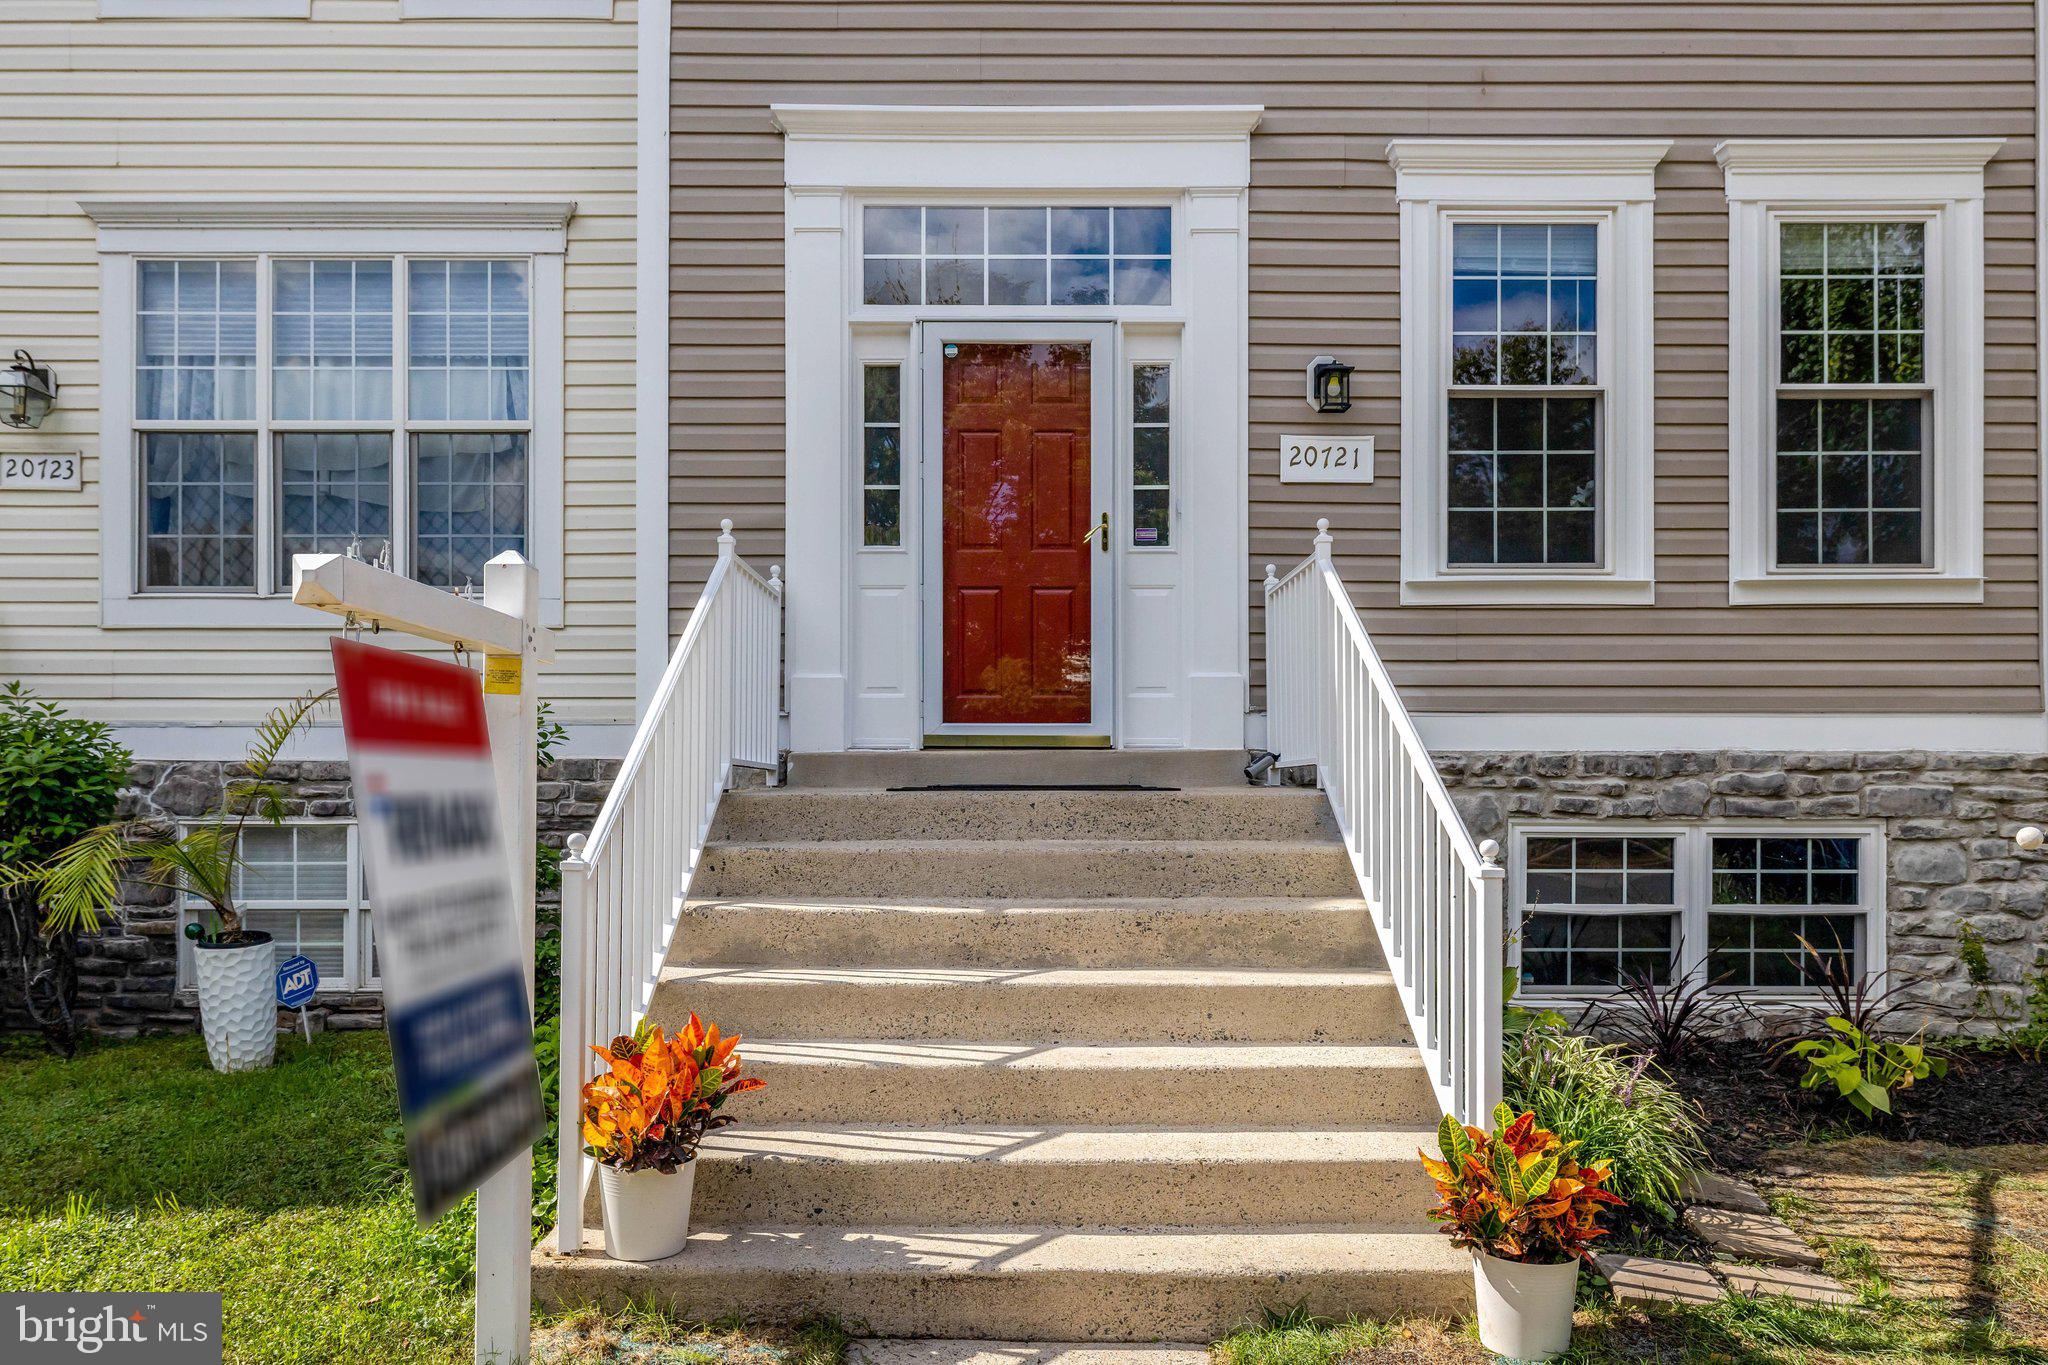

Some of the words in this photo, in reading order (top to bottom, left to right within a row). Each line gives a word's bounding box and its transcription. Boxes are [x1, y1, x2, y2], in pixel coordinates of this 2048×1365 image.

[6, 458, 75, 480] 20723
[1289, 445, 1359, 470] 20721
[283, 967, 312, 995] ADT
